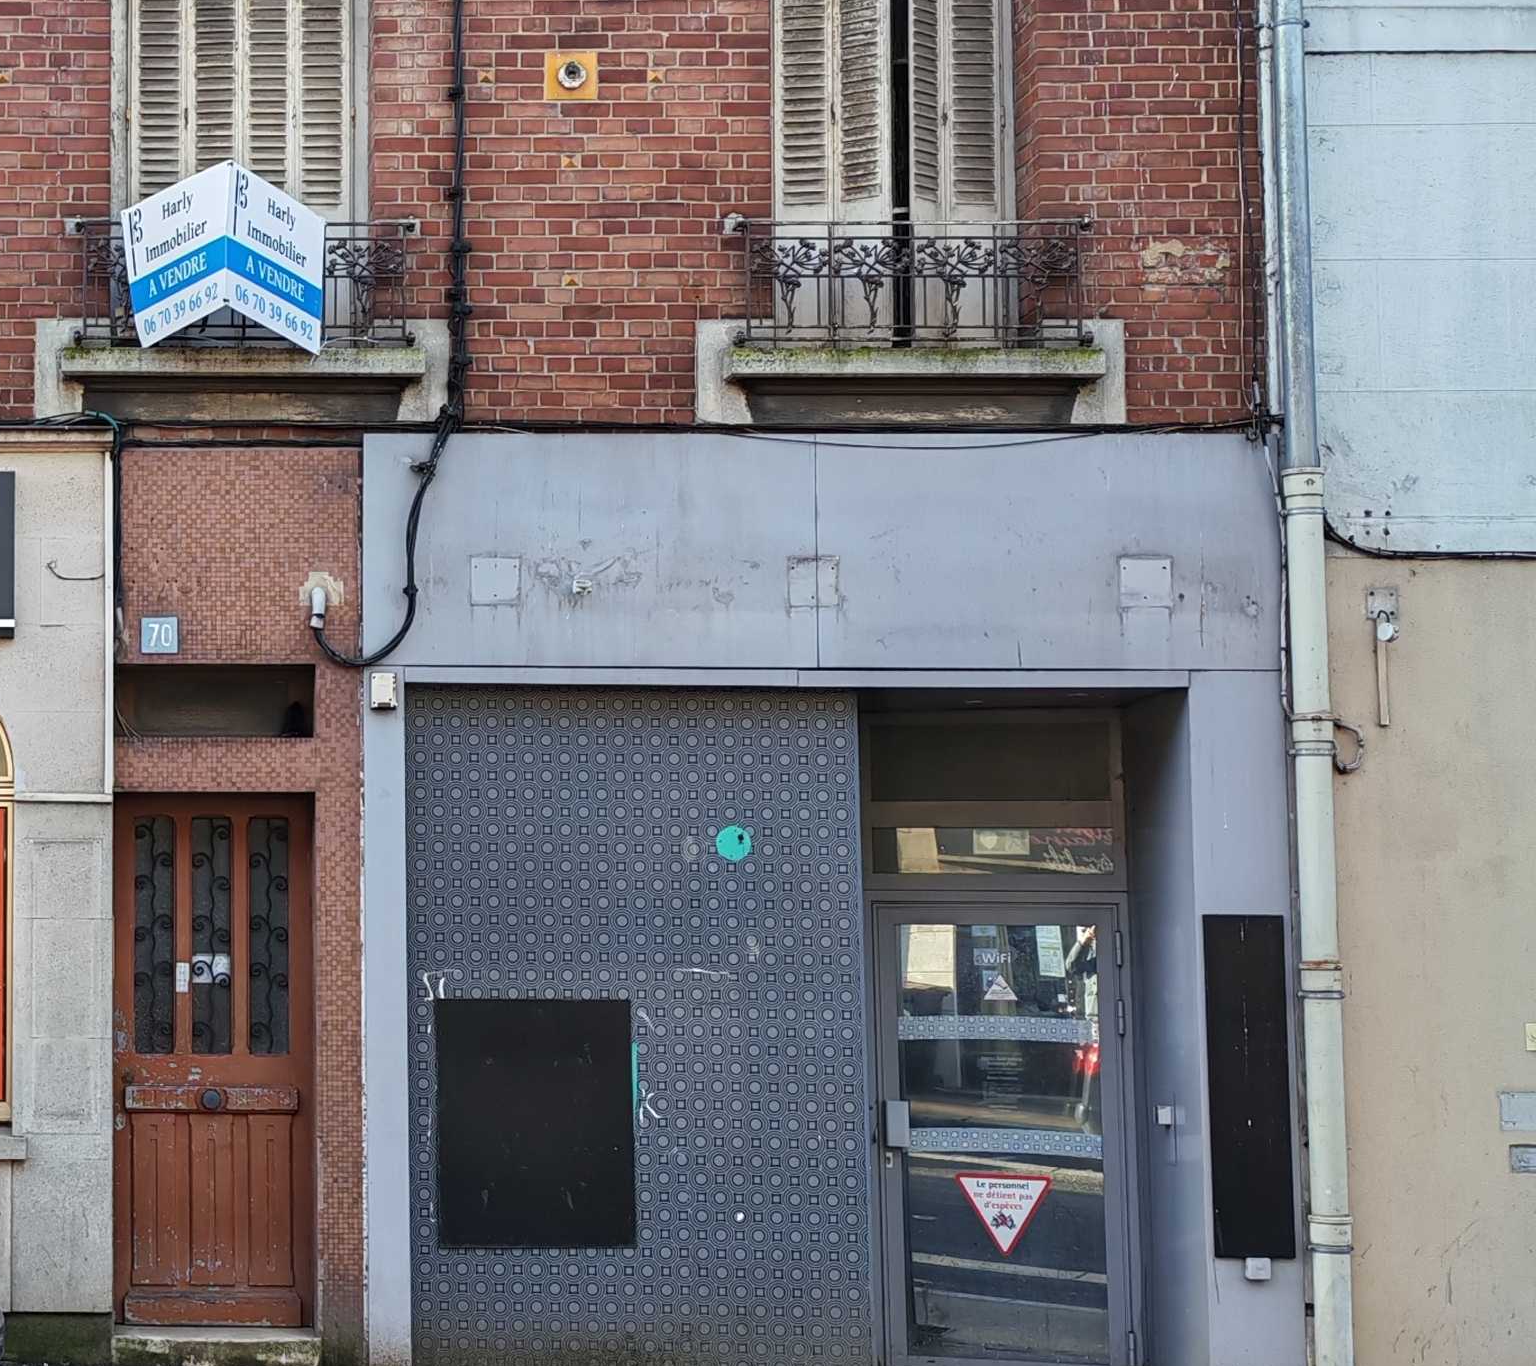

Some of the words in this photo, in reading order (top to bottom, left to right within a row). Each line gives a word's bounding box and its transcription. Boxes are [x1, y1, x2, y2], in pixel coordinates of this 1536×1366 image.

[162, 191, 193, 220] Harly
[267, 197, 296, 230] Harly
[145, 217, 207, 263] Immobilier
[247, 221, 307, 268] Immobilier
[149, 282, 158, 298] A
[158, 251, 207, 291] VENDRE
[246, 259, 254, 275] A
[256, 263, 305, 302] VENDRE
[144, 316, 157, 336] 06
[158, 308, 172, 328] 70
[173, 299, 186, 319] 39
[189, 292, 202, 312] 66
[205, 283, 219, 303] 92
[235, 284, 249, 304] 06
[252, 293, 266, 314] 70
[269, 302, 282, 323] 39
[285, 310, 298, 331] 66
[299, 319, 313, 341] 92
[147, 622, 174, 648] 70
[982, 952, 1011, 963] WiFi
[976, 1180, 985, 1188] Le
[988, 1181, 1030, 1190] personnel
[985, 1191, 1016, 1200] détient
[1019, 1193, 1033, 1201] pas
